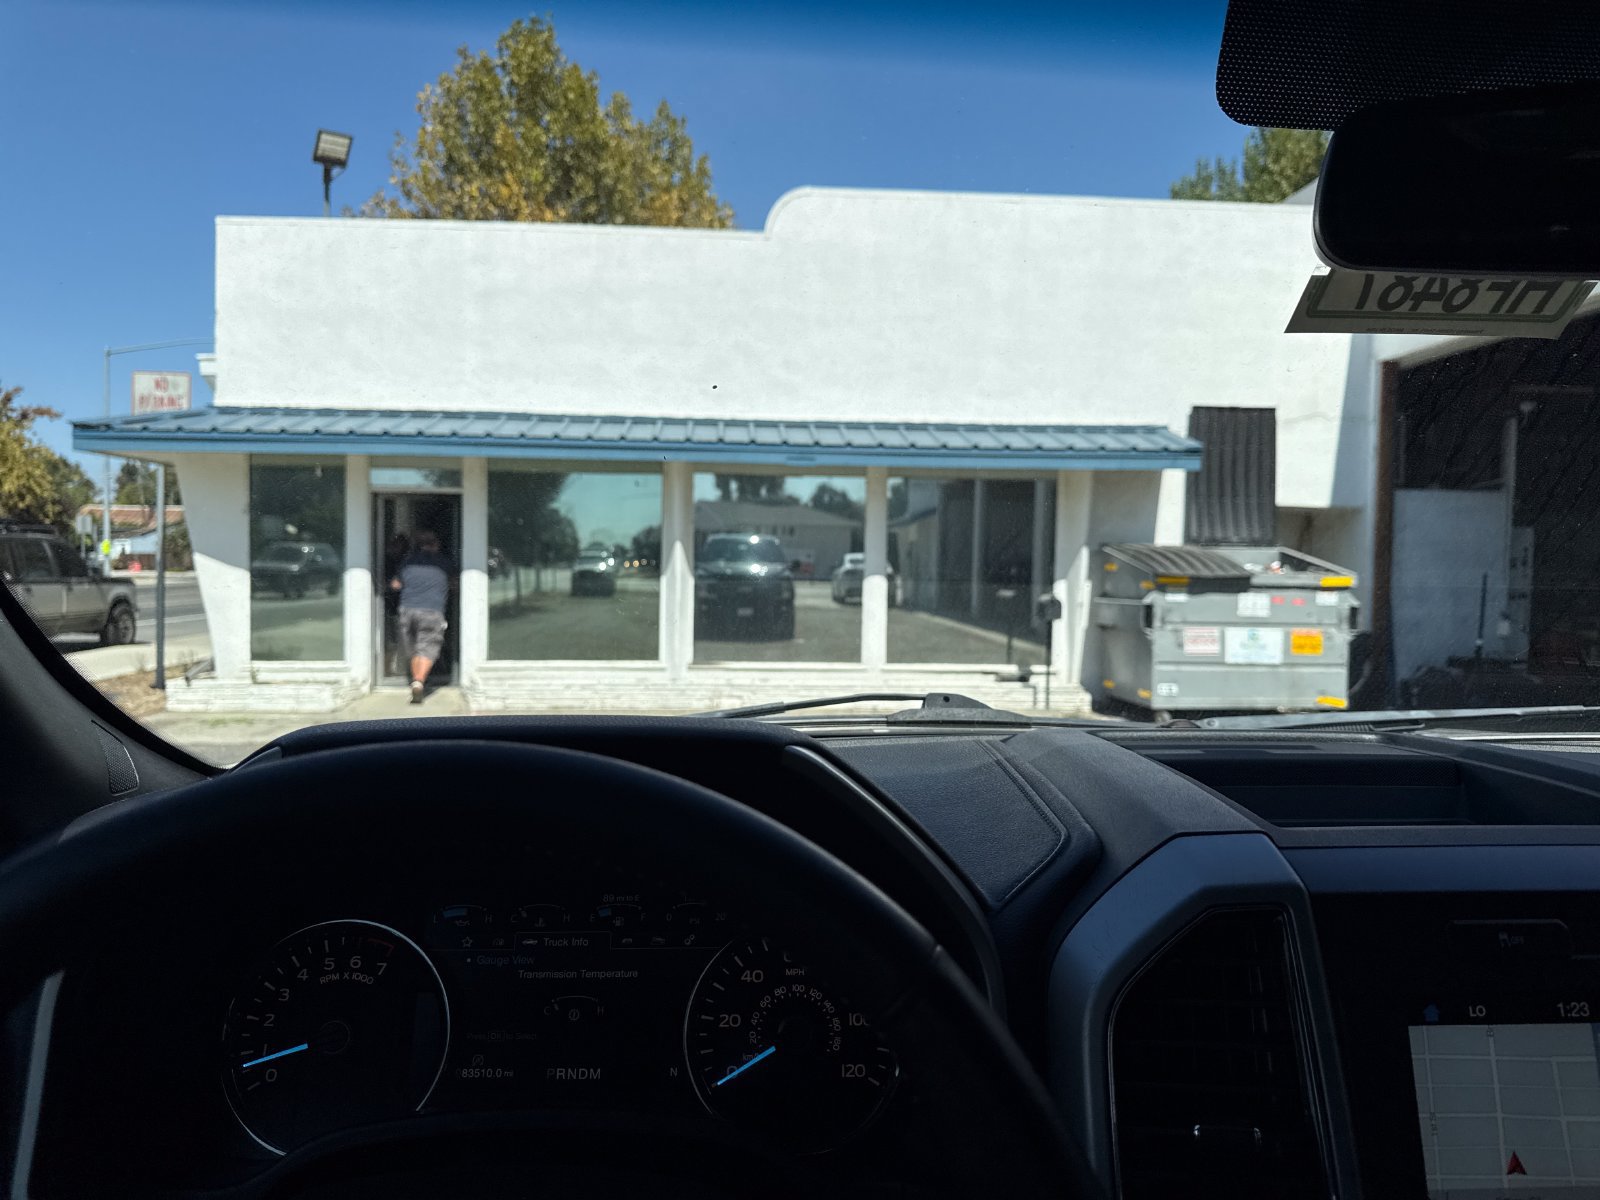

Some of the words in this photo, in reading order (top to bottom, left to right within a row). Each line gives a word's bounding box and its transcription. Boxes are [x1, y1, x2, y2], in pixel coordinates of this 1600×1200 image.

[543, 937, 569, 947] Truck
[571, 937, 589, 947] Info
[323, 957, 335, 970] 5
[350, 955, 362, 968] 6
[476, 955, 509, 966] Gauge
[512, 954, 535, 965] View
[297, 968, 309, 981] 4
[376, 962, 388, 975] 7
[518, 969, 578, 979] Transmission
[580, 969, 638, 981] Temperature
[785, 968, 805, 976] MPH
[319, 972, 340, 985] RPM
[351, 972, 375, 985] 1000
[740, 969, 764, 983] 40
[278, 988, 290, 1001] 3
[774, 985, 787, 996] 80
[791, 984, 805, 993] 100
[809, 987, 823, 1000] 120
[759, 995, 772, 1008] 60
[1468, 1004, 1488, 1018] LO
[1556, 1001, 1591, 1018] 1:23
[263, 1013, 275, 1027] 2
[719, 1013, 741, 1027] 20
[750, 1011, 760, 1026] 40
[749, 1031, 757, 1044] 20
[265, 1068, 277, 1082] 0
[669, 1067, 678, 1077] N
[841, 1063, 866, 1078] 120
